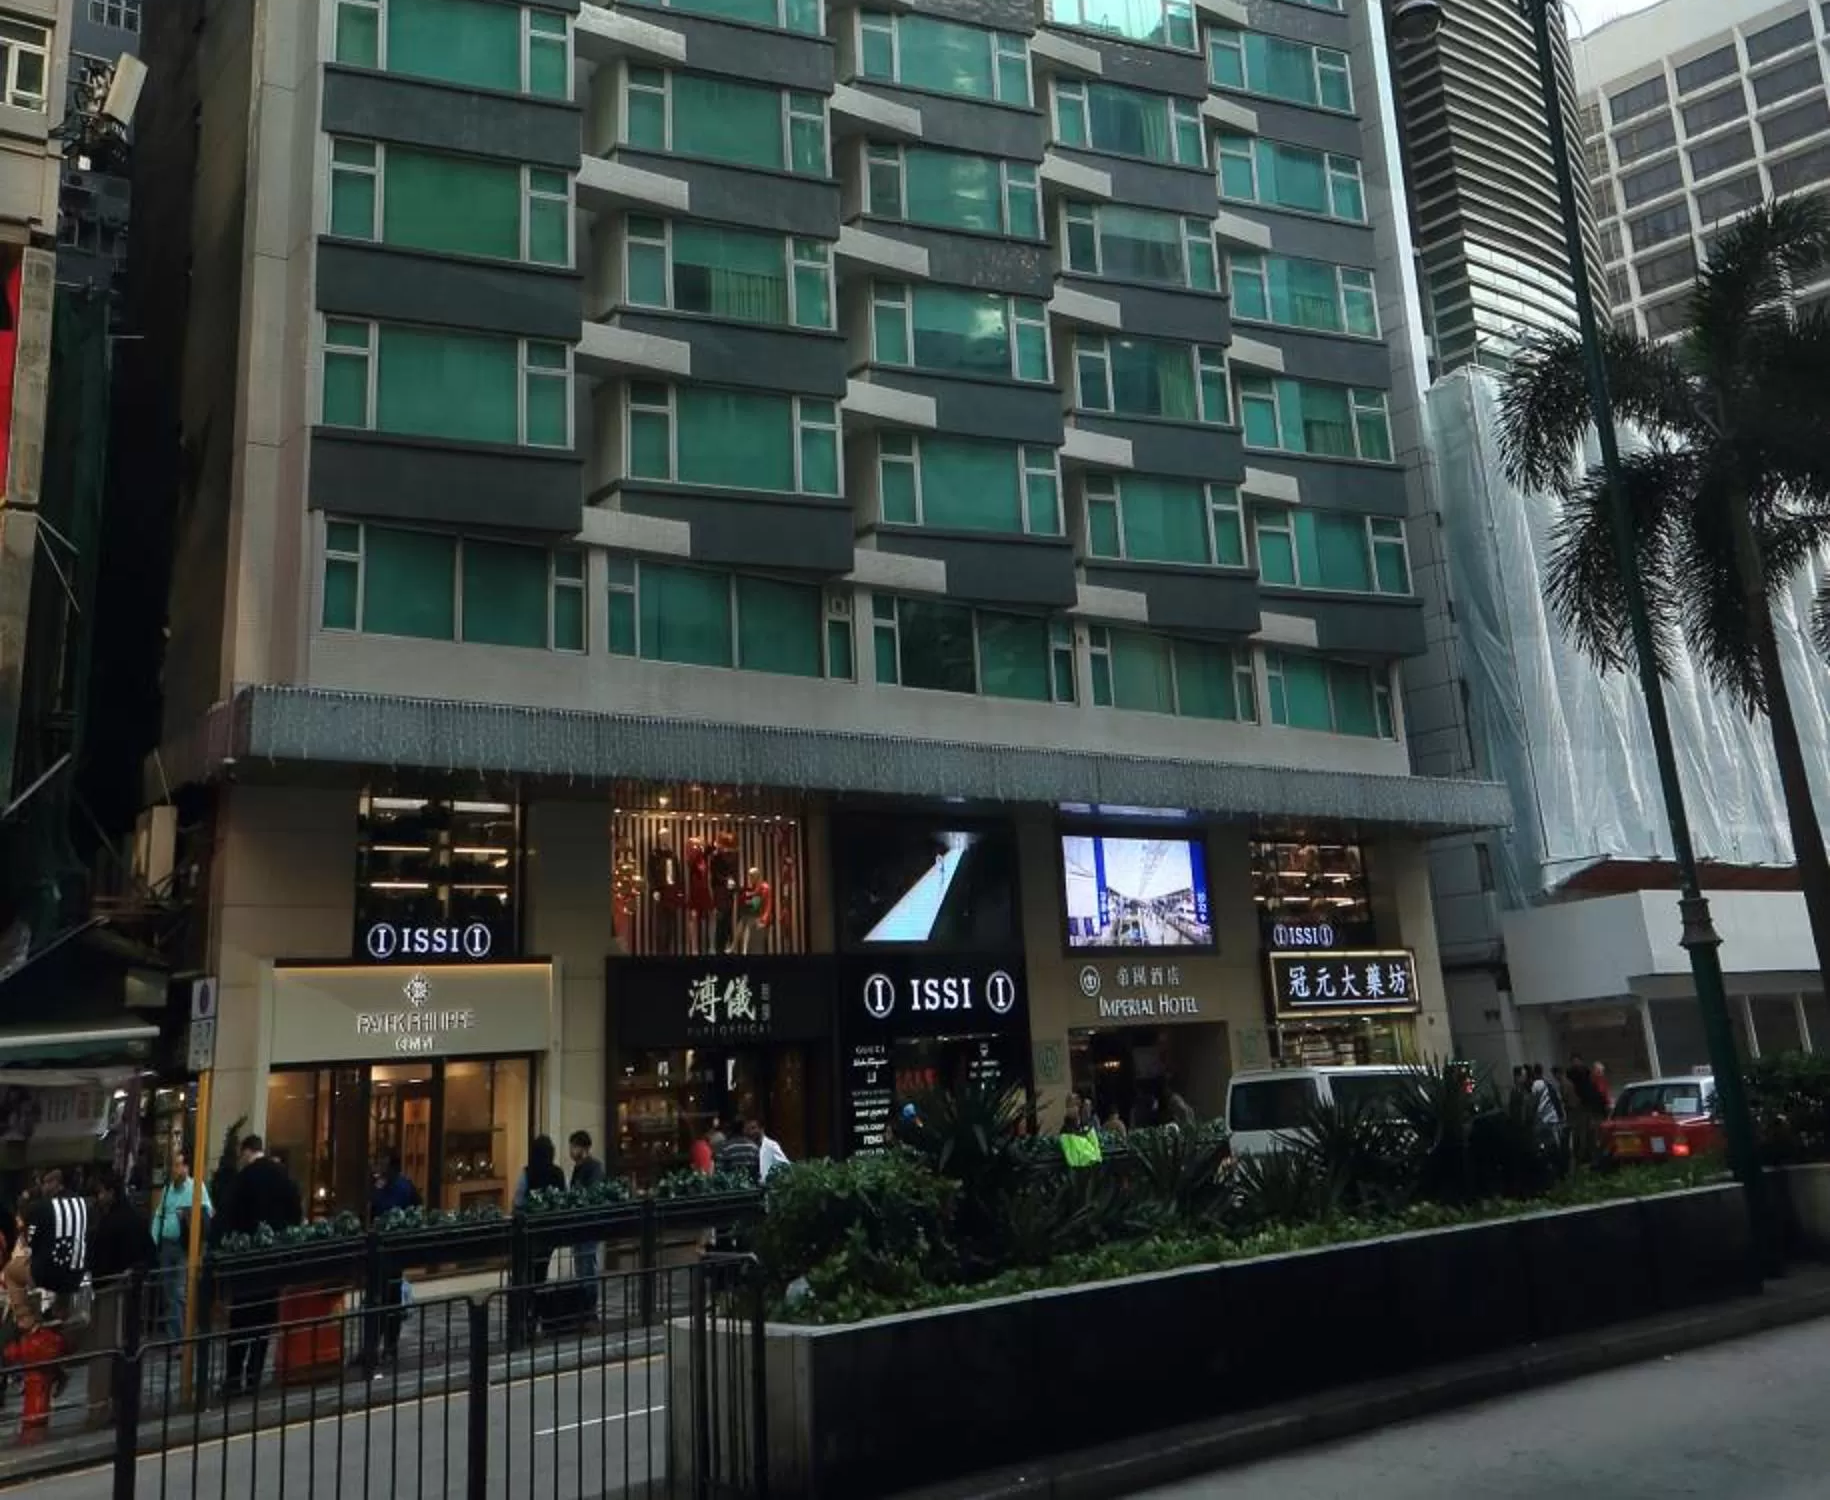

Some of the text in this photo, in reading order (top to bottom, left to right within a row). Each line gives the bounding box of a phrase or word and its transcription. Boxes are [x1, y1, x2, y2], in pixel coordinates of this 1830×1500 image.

[401, 927, 459, 953] ISSI
[1289, 926, 1319, 945] ISSI
[910, 977, 972, 1011] ISSI
[1289, 962, 1409, 998] 冠元大藥坊
